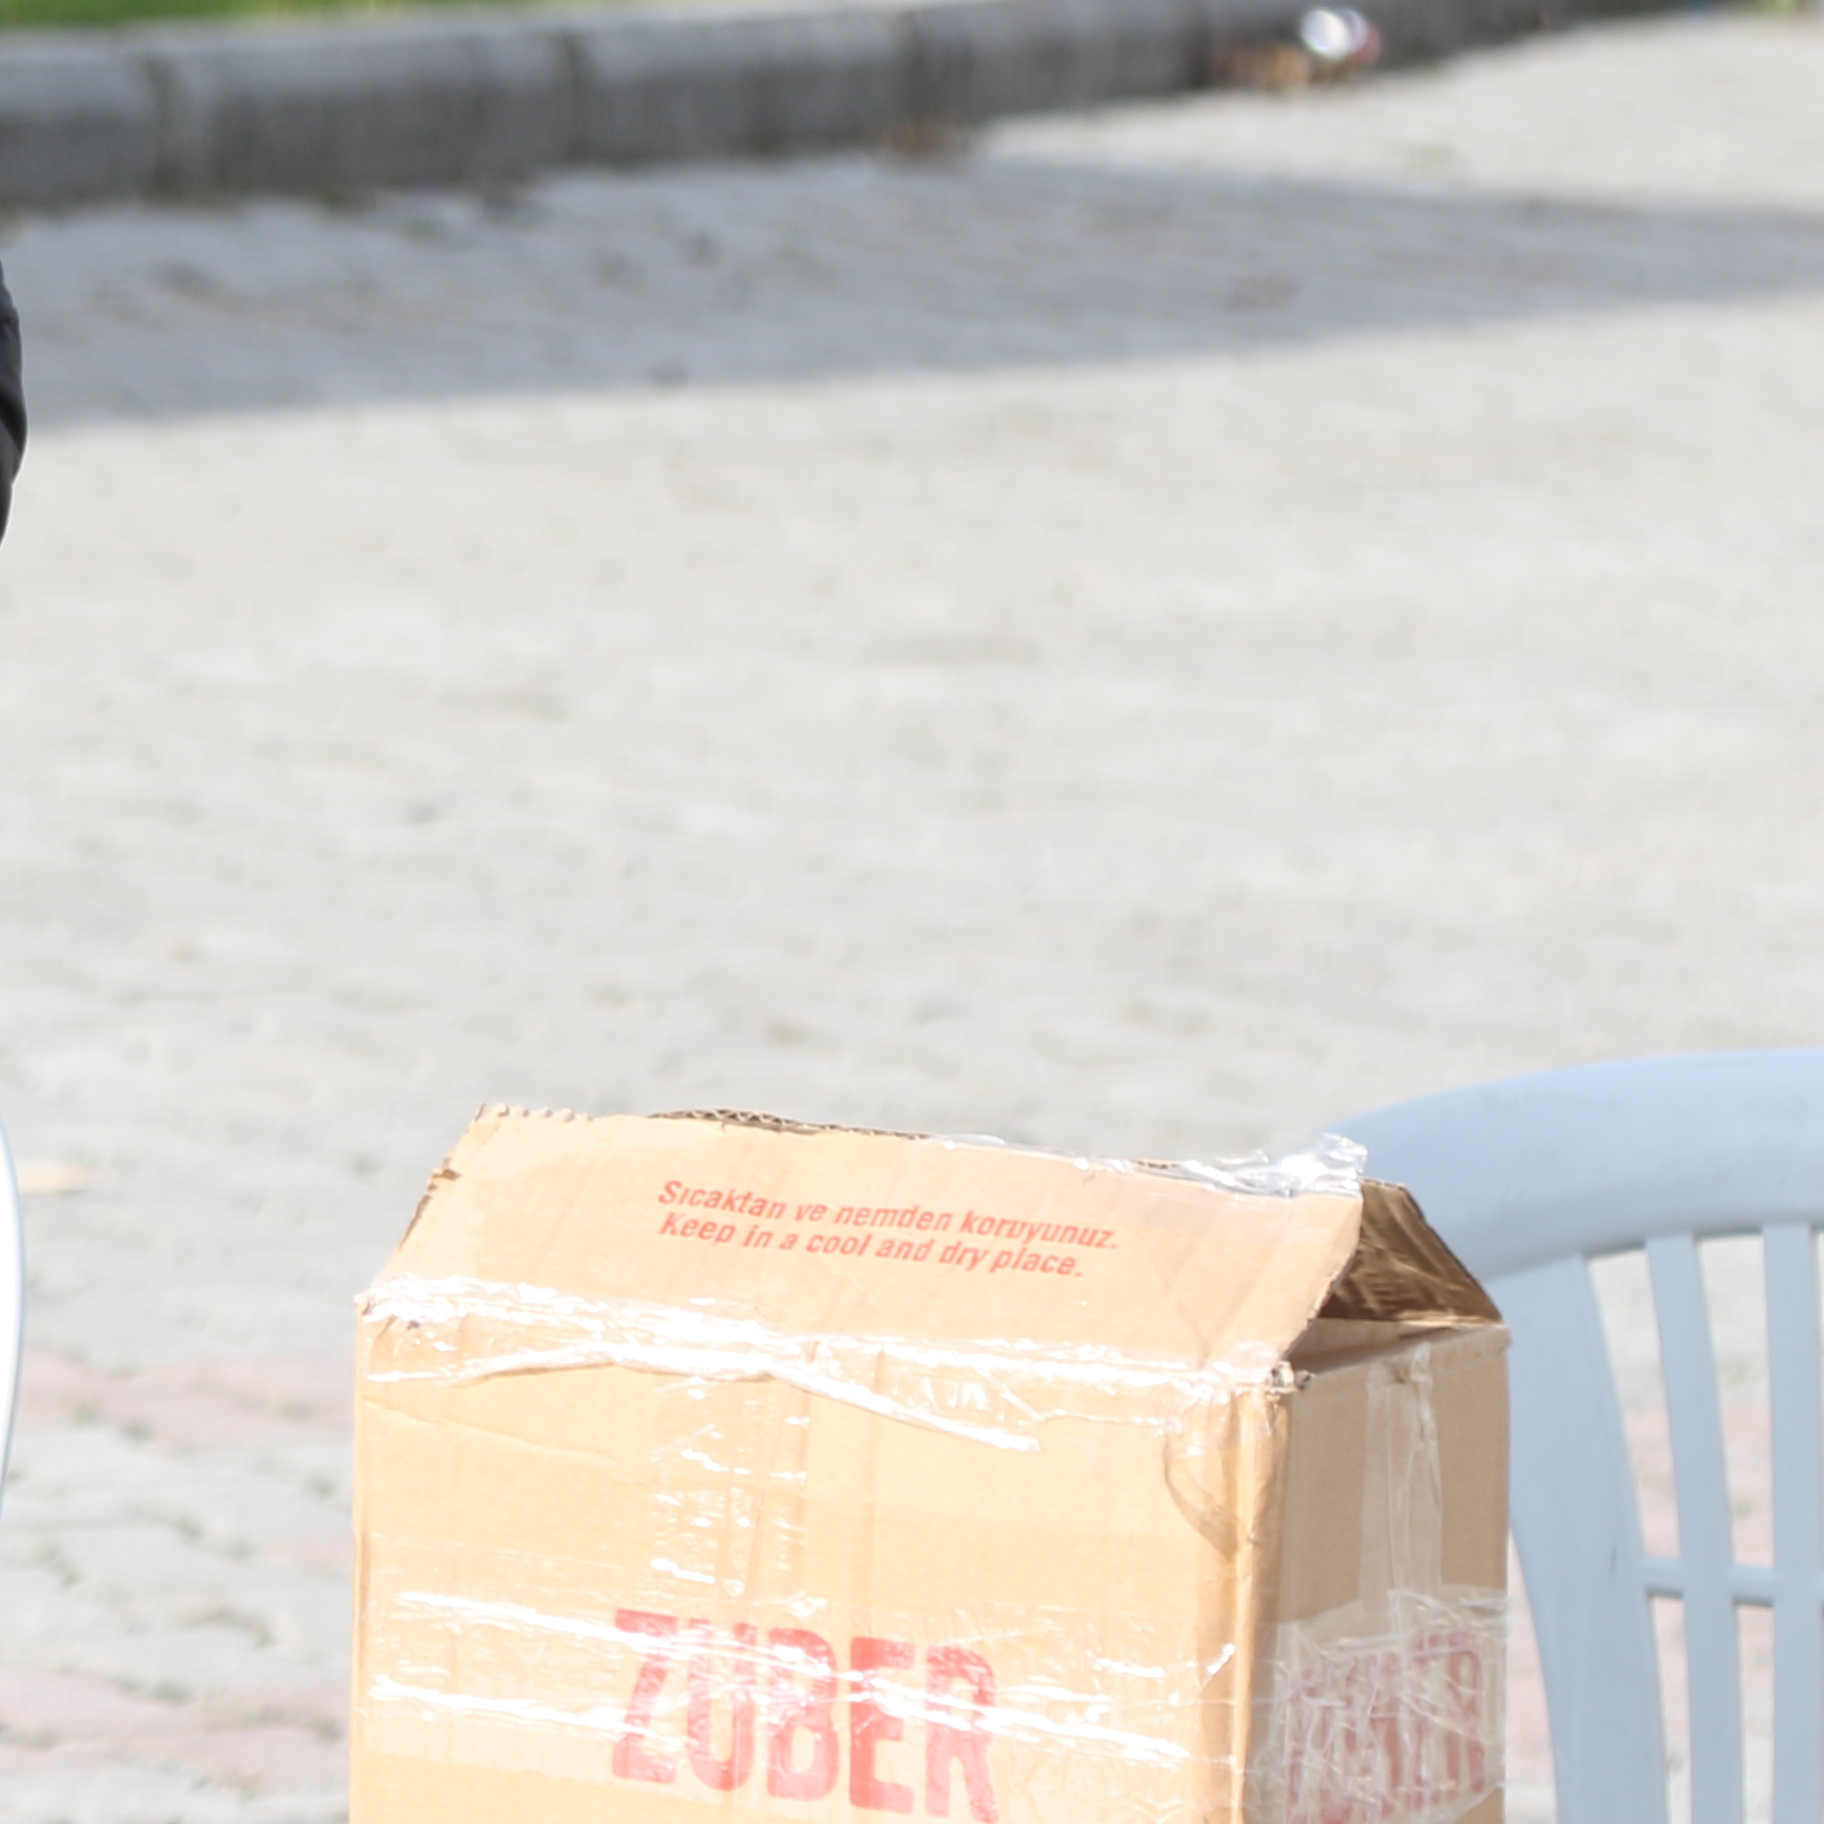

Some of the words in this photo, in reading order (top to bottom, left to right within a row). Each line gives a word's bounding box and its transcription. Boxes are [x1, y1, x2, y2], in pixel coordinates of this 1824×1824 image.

[657, 1178, 788, 1221] Sıcaktan
[794, 1201, 828, 1223] ve
[833, 1204, 954, 1234] nemden
[958, 1208, 1119, 1251] koruyunuz.
[658, 1211, 737, 1245] Keep
[742, 1223, 773, 1250] in
[779, 1231, 798, 1251] a
[805, 1232, 871, 1257] cool
[875, 1237, 934, 1263] and
[938, 1244, 988, 1272] dry
[989, 1248, 1084, 1279] place.
[610, 1607, 1000, 1824] ZUBER
